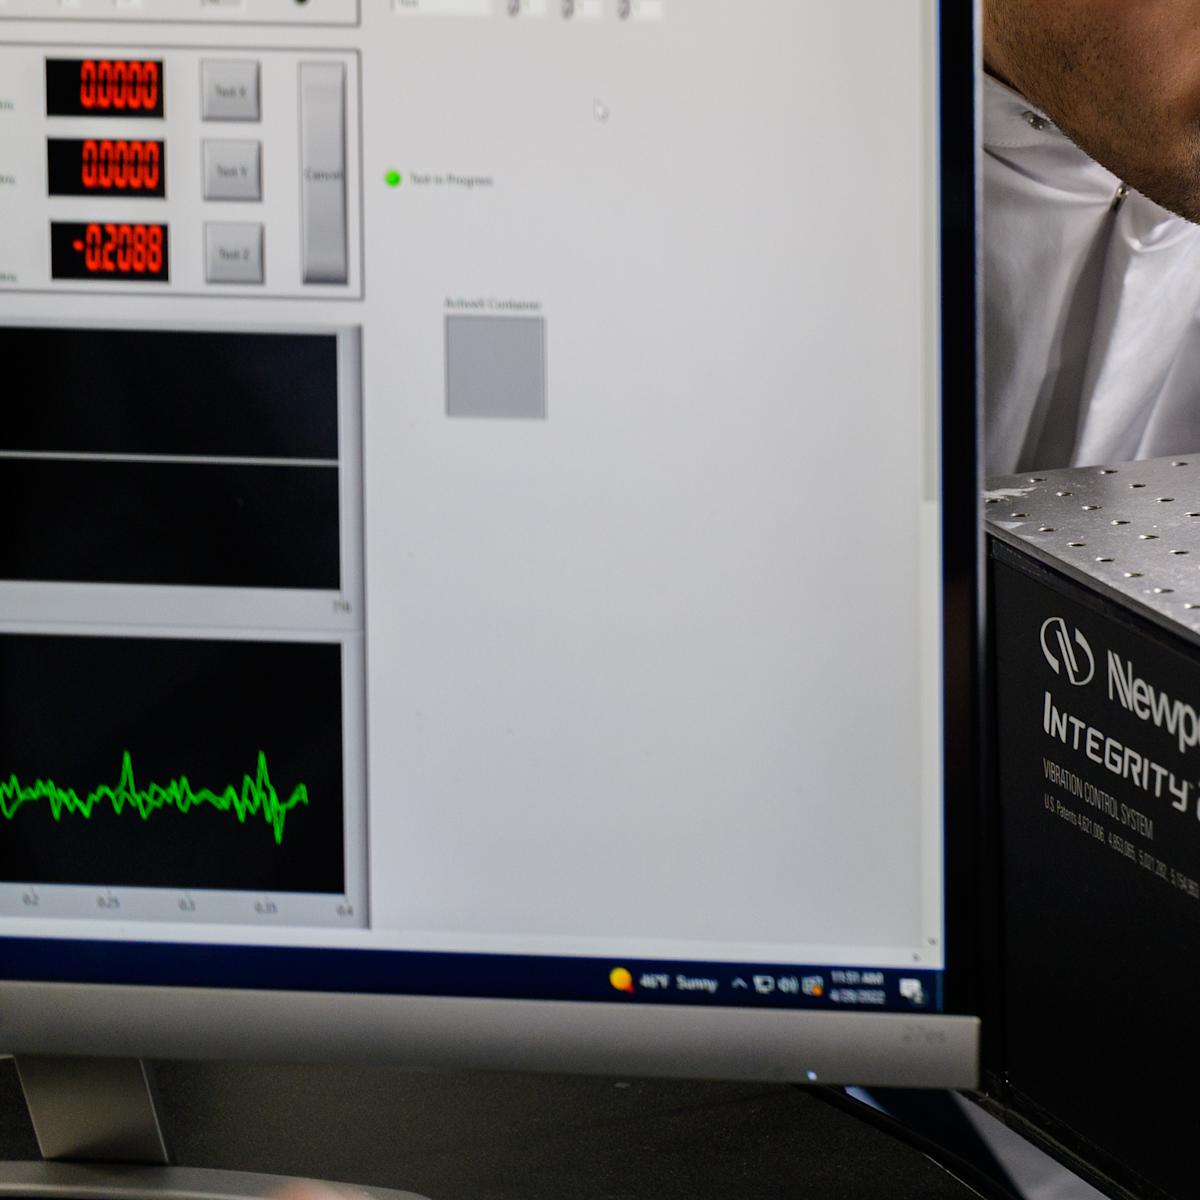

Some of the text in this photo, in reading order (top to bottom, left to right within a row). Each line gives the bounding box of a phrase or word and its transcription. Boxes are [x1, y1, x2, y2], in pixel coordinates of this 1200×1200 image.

[1042, 757, 1154, 841] VIBRATION CONTROL SYSTEM
[675, 973, 719, 994] Sunny
